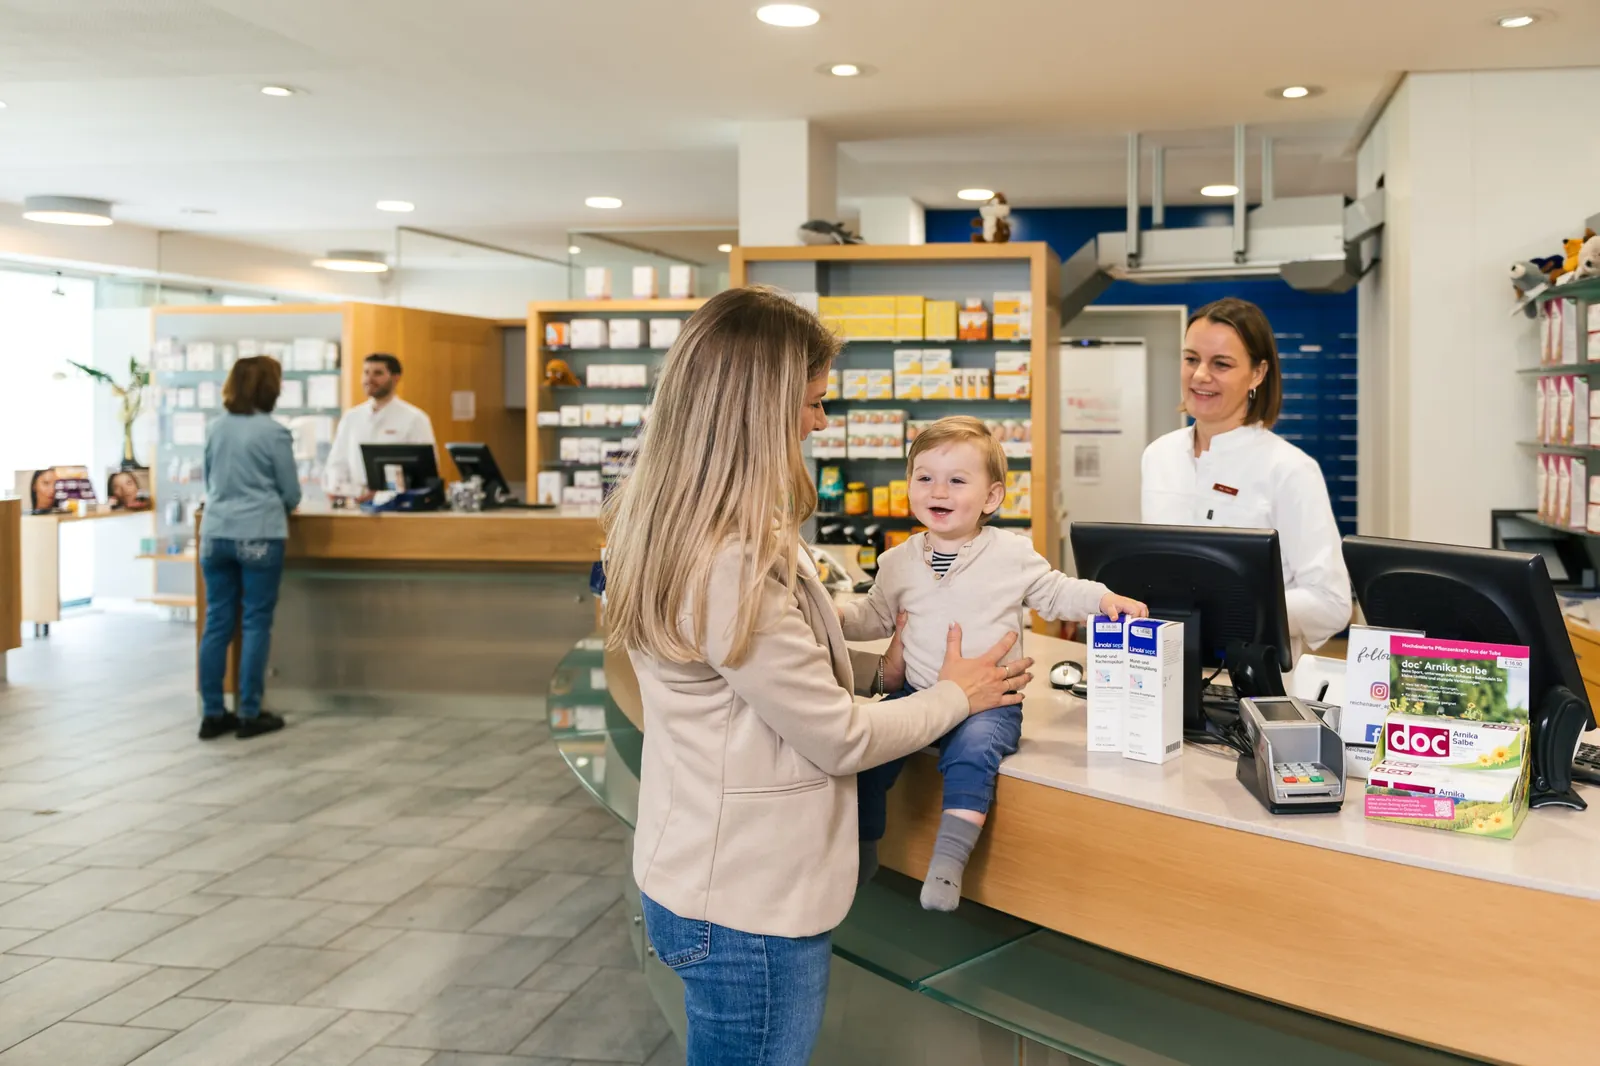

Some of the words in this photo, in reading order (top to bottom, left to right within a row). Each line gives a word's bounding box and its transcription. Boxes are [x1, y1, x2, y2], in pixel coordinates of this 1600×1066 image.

[1434, 645, 1469, 654] Pflanzenkraft
[1424, 661, 1458, 673] Arnika
[1459, 664, 1488, 676] Salbe
[1452, 730, 1479, 740] Arnika
[1452, 738, 1474, 747] Salbe
[1439, 788, 1465, 798] Arnika
